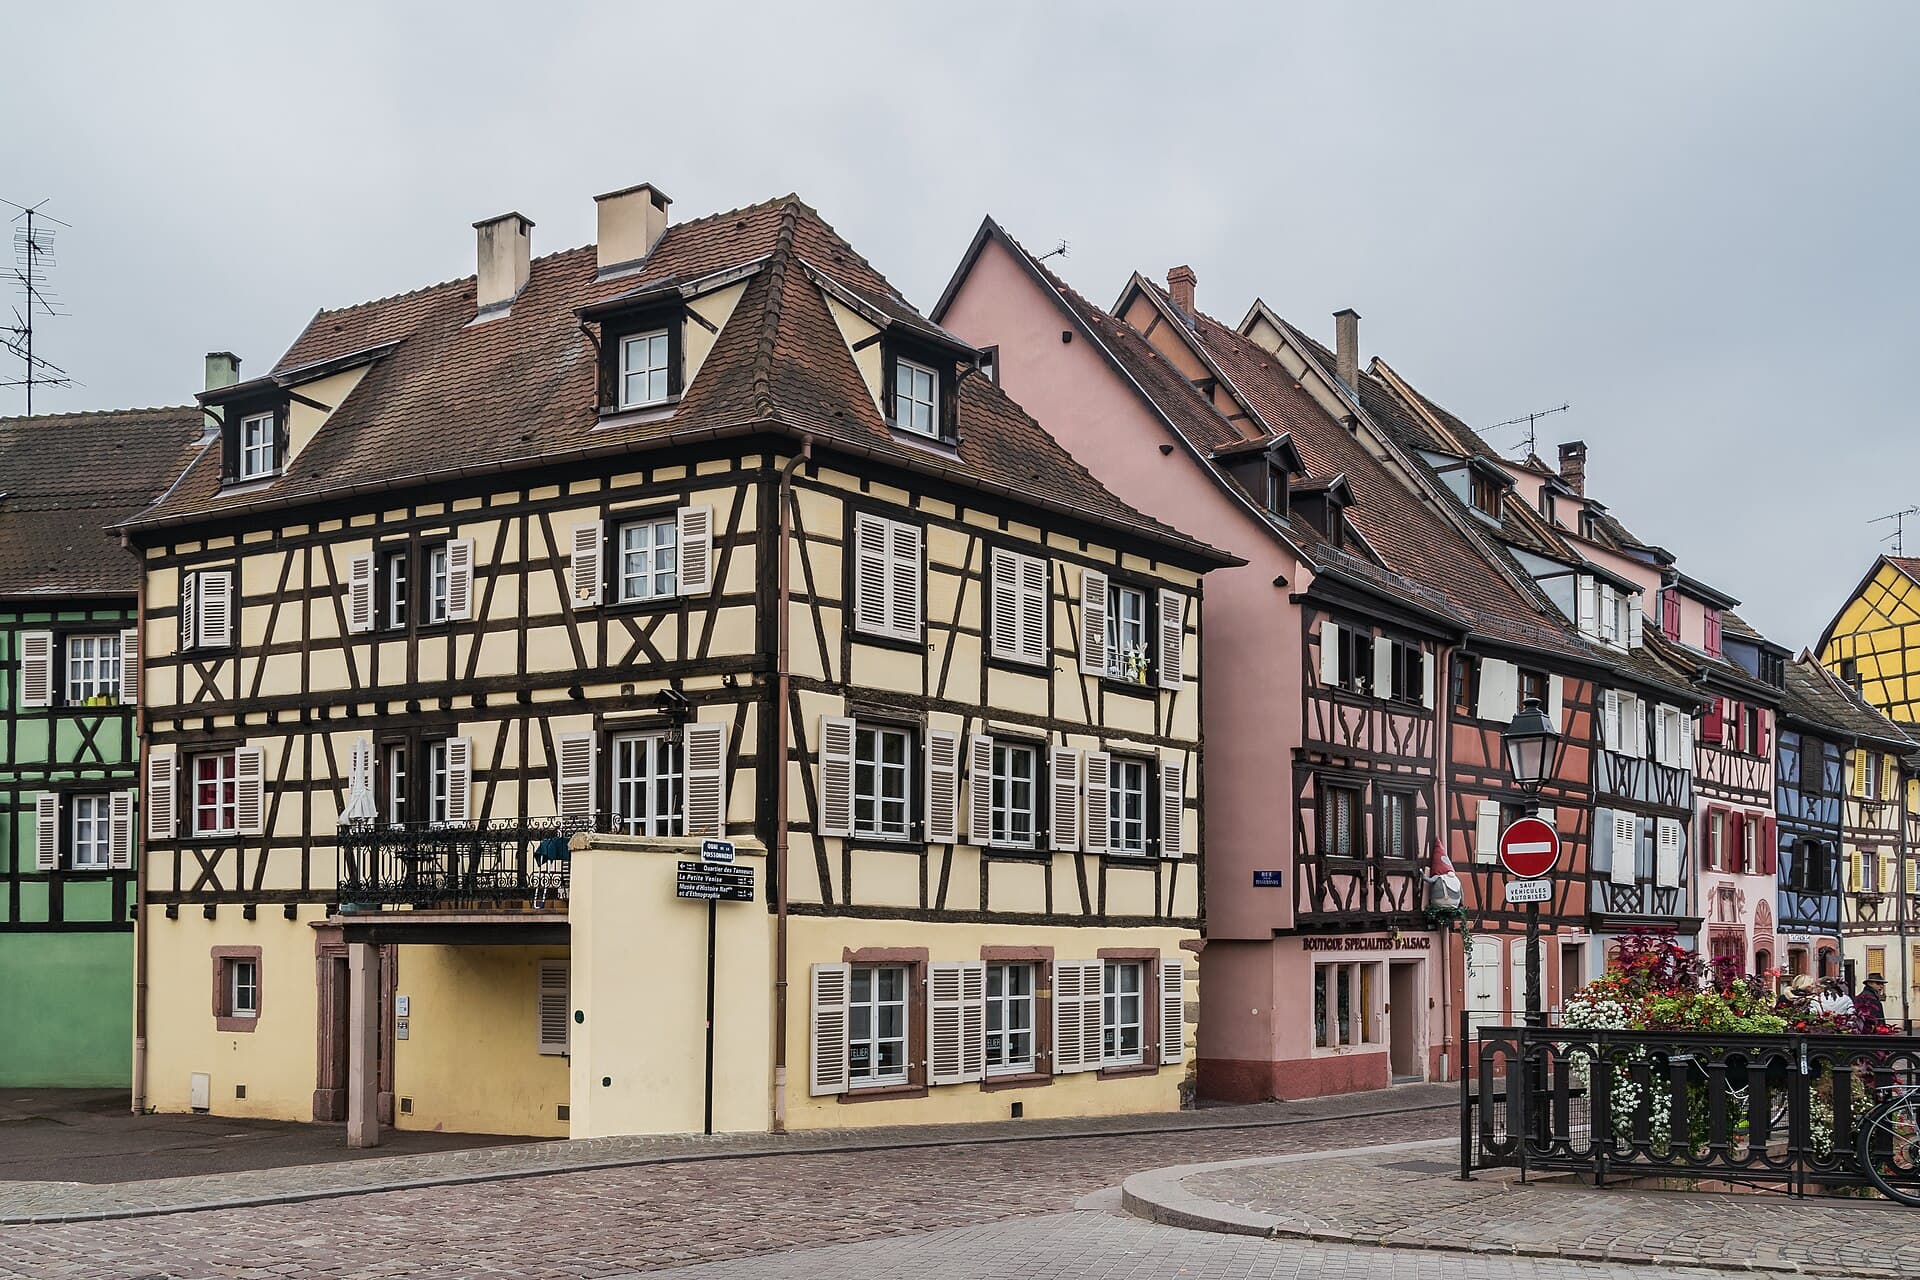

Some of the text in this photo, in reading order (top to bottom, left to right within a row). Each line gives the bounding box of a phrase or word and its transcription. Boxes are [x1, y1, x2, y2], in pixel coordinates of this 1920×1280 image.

[703, 851, 733, 860] POISSONNERIE
[703, 864, 723, 873] Quartier
[733, 867, 753, 875] Tanneurs
[686, 874, 704, 882] Petite
[704, 875, 723, 883] Venise
[695, 884, 719, 892] d'Histoire
[1303, 937, 1343, 951] BOUTIQUE
[1344, 937, 1393, 950] SPECIALITES
[850, 1047, 869, 1058] TELIER
